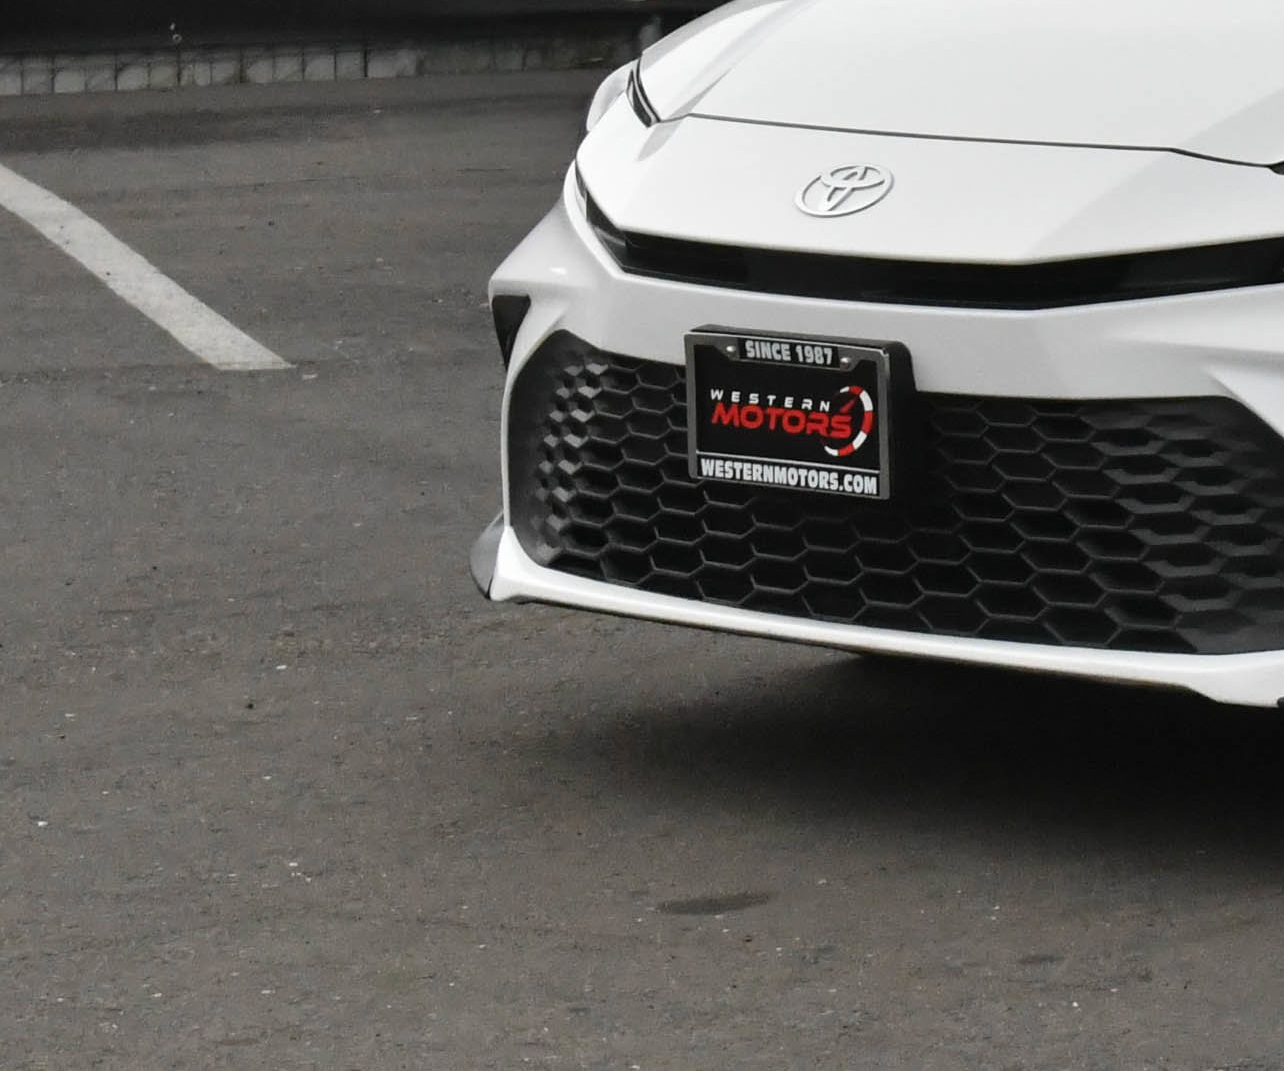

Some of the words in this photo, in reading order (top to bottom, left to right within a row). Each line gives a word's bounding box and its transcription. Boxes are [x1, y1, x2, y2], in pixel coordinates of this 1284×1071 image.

[745, 340, 791, 362] SINCE
[795, 346, 833, 365] 1987
[710, 388, 831, 412] WESTERN
[712, 402, 852, 438] MOTORS
[700, 459, 877, 495] WESTERNMOTORS.COM
